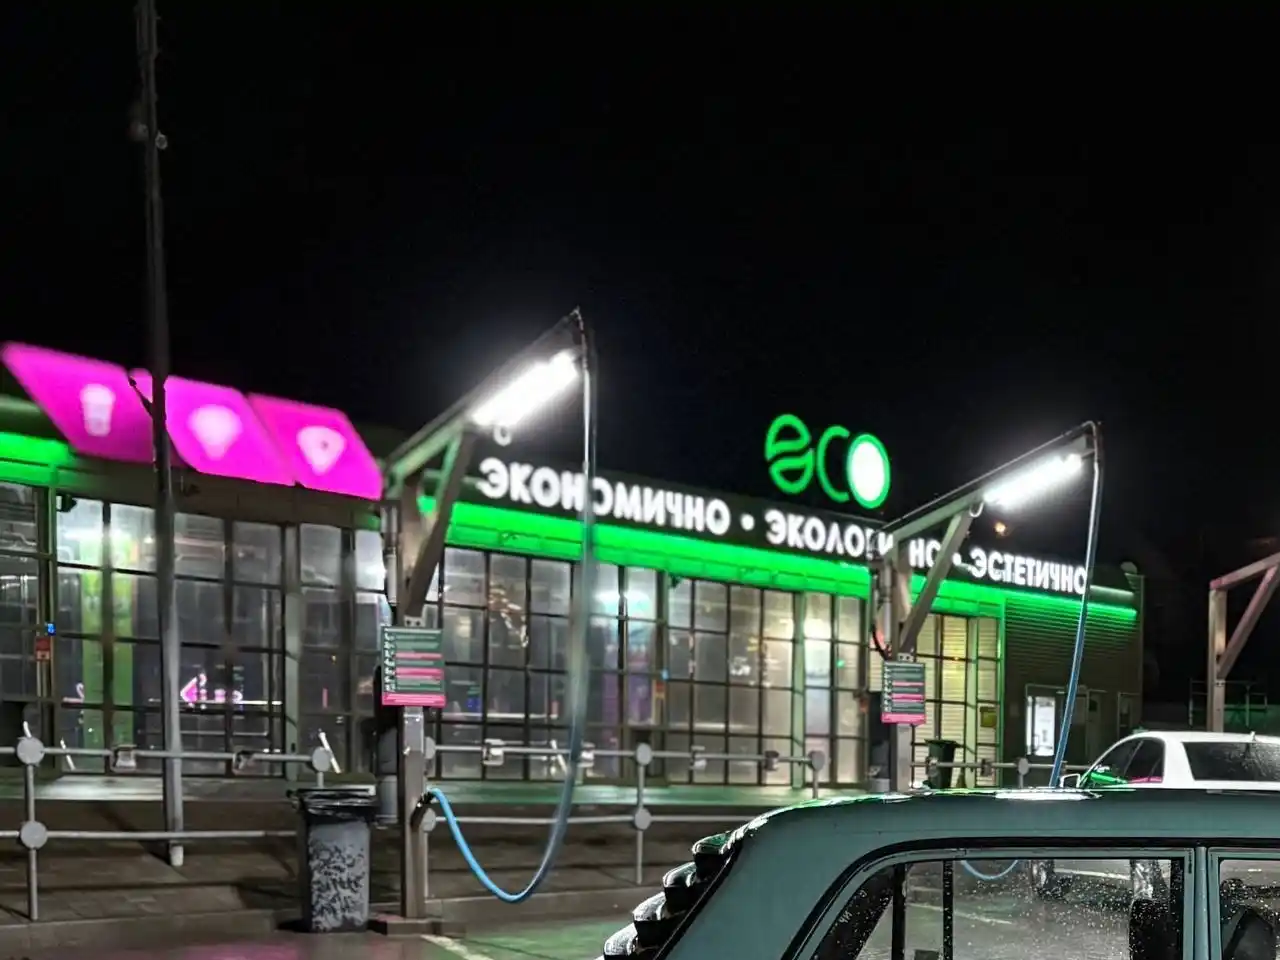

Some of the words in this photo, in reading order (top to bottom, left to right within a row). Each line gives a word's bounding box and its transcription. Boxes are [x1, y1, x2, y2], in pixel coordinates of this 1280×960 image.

[478, 456, 731, 536] ЭКОНОМИЧНО
[764, 508, 940, 568] ЭКОЛОГИНО
[969, 545, 1088, 595] ЭСТЕТИЧНО
